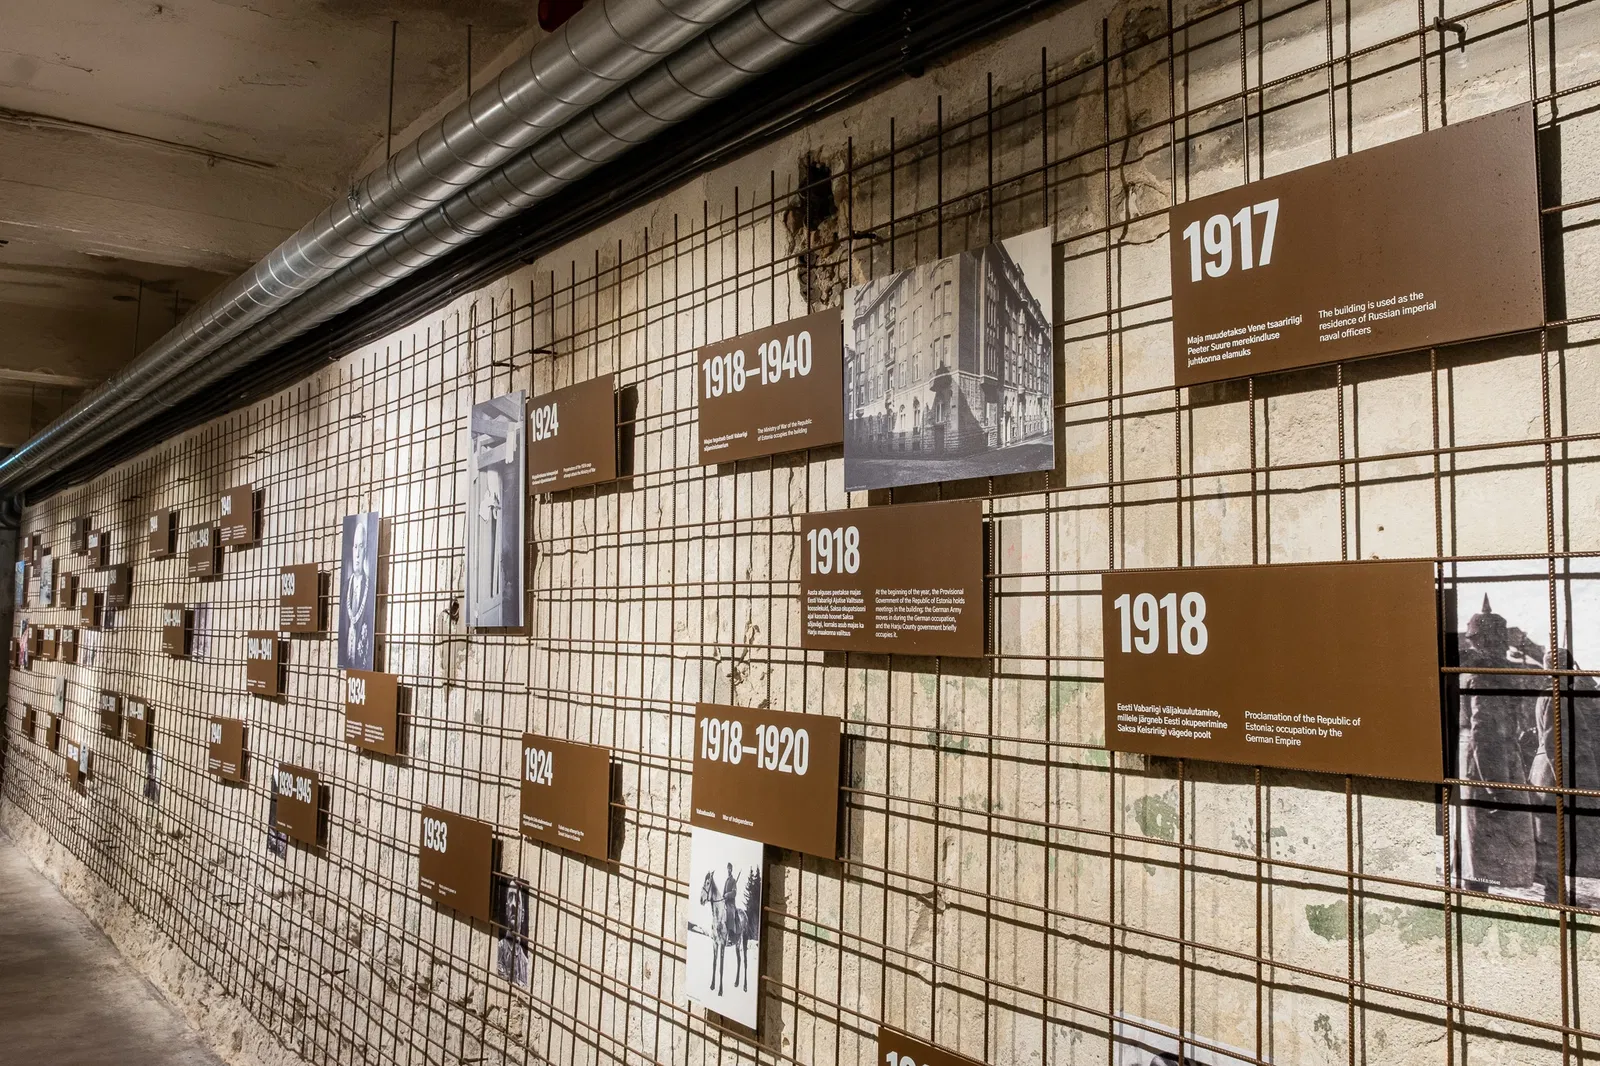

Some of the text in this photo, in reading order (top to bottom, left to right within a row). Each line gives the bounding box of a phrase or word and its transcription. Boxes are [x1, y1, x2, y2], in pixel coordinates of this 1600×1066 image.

[1183, 198, 1279, 282] 1917
[1319, 292, 1424, 319] The building is used as the
[1319, 301, 1436, 330] residence of Russian imperial
[1188, 314, 1302, 345] Maja muudetakse Vene tsaaririigi
[1188, 332, 1280, 355] Peeter Suure merekindluse
[1320, 326, 1371, 341] naval officers
[703, 331, 812, 399] 1918–1940
[1188, 348, 1251, 367] juhtkonna elamuks
[531, 403, 559, 442] 1924
[807, 526, 860, 574] 1918
[1114, 591, 1208, 655] 1918
[348, 677, 365, 705] 1934
[1117, 703, 1132, 711] Eesti
[1134, 704, 1161, 714] Vabariigi
[1117, 714, 1228, 729] millele järgneb Eesti okupeerimine
[1245, 711, 1361, 726] Proclamation of the Republic of
[1118, 724, 1211, 739] Saksa Keisririigi vägede poolt
[1246, 734, 1301, 747] German Empire
[1276, 726, 1316, 735] occupation
[1318, 727, 1327, 738] by
[1330, 728, 1342, 737] the
[700, 718, 809, 775] 1918–1920
[525, 747, 552, 786] 1924
[424, 817, 447, 853] 1933
